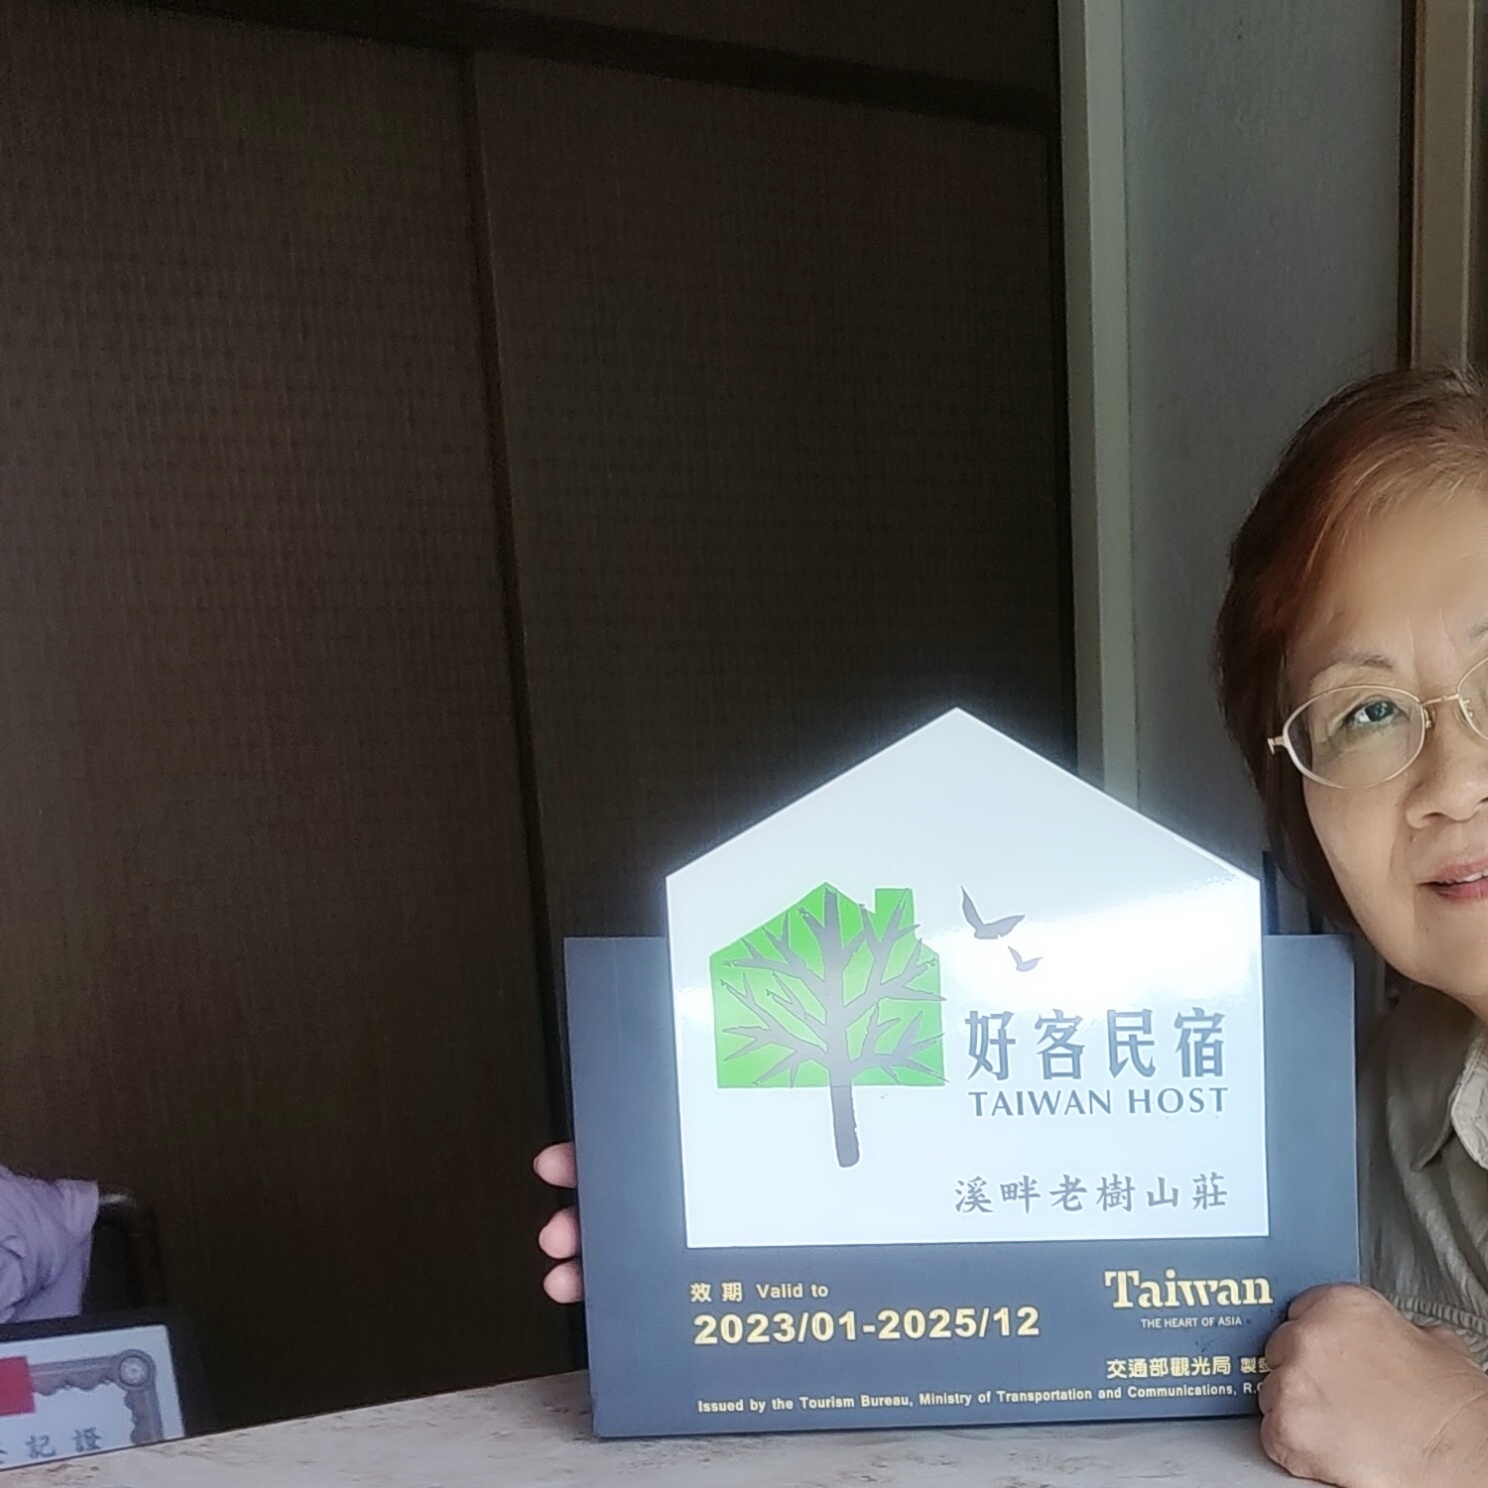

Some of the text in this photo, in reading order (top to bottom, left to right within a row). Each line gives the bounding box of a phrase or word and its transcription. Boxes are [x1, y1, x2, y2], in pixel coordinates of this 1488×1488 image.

[964, 1007, 1226, 1080] 好客民宿
[968, 1087, 1228, 1116] TAIWAN HOST
[954, 1172, 1228, 1214] 溪畔老樹山莊
[756, 1284, 803, 1300] Valid
[811, 1284, 829, 1299] to
[1104, 1269, 1274, 1309] Taiwan
[693, 1306, 1040, 1345] 2023/01-2025/12
[1140, 1316, 1242, 1329] THE HEART OF ASIA
[698, 1399, 744, 1413] Issued
[749, 1398, 766, 1414] by
[772, 1397, 793, 1411] the
[799, 1395, 855, 1410] Tourism
[861, 1393, 914, 1408] Bureau,
[919, 1392, 972, 1409] Ministry
[978, 1390, 992, 1404] of
[996, 1387, 1092, 1404] Transportation
[1098, 1386, 1122, 1399] and
[1127, 1382, 1237, 1399] Communications,
[0, 1426, 101, 1463] 記證
